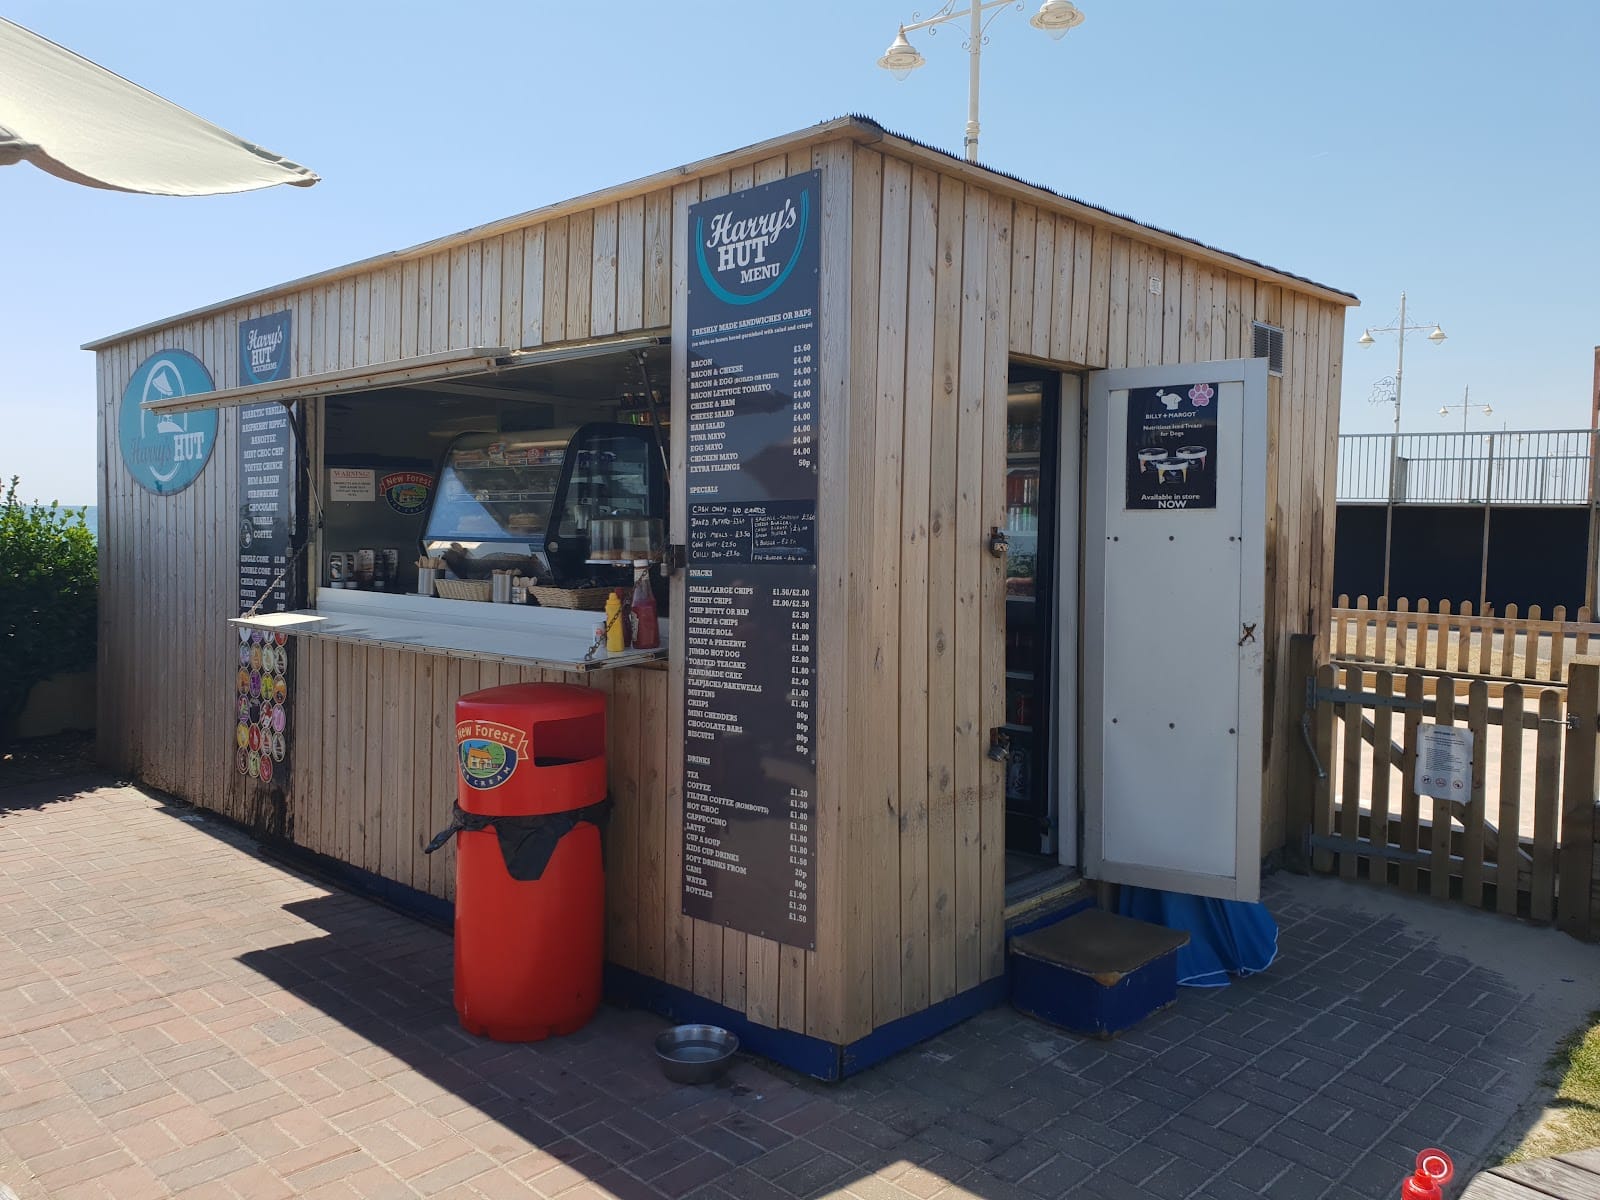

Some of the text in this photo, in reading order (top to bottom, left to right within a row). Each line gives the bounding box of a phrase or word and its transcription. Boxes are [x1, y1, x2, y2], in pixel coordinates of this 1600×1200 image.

[707, 198, 796, 248] Harry's
[718, 236, 768, 271] HUT
[741, 263, 780, 283] MENU
[692, 308, 811, 336] FRESHLY MADE SANDWICHES OR BAPS
[247, 325, 282, 351] Harry's
[252, 346, 271, 366] HUT
[691, 344, 811, 368] BACON £3.60
[691, 370, 712, 379] BACON
[720, 365, 743, 375] CHEESE
[691, 380, 712, 390] BACON
[719, 377, 733, 386] EGG
[691, 383, 771, 400] BACON LETTUCE TOMATO
[691, 402, 713, 411] CHEESE
[721, 399, 735, 407] HAM
[794, 390, 811, 399] £4.00
[691, 402, 811, 421] CHEESE SALAD £4.00
[706, 422, 725, 430] SALAD
[794, 414, 811, 422] £4.00
[708, 433, 726, 441] MAYO
[793, 425, 811, 433] £4.00
[174, 432, 204, 461] HUT
[793, 437, 810, 445] £4.00
[257, 448, 271, 457] CHOC
[691, 455, 718, 463] CHICKEN
[793, 448, 810, 456] £4.00
[711, 464, 740, 472] FILLINGS
[799, 460, 810, 468] 50p
[387, 475, 432, 486] New Forest
[717, 661, 746, 669] TEACAKE
[688, 669, 724, 678] HANDMADE
[688, 690, 715, 698] MUFFINS
[704, 712, 738, 722] CHEDDERS
[688, 720, 726, 730] CHOCOLATE
[475, 725, 516, 744] Forest
[688, 731, 715, 740] BISCUITS
[688, 756, 710, 765] DRINKS
[687, 782, 808, 809] COFFEE £1.50
[687, 792, 708, 802] FILTER
[709, 796, 734, 806] COFFEE
[790, 788, 808, 798] £1.20
[687, 802, 700, 811] HOT
[701, 805, 719, 814] CHOC
[687, 813, 727, 827] CAPPUCCINO
[686, 823, 706, 833] LATTE
[686, 834, 698, 842] CUP
[705, 838, 720, 847] SOUP
[686, 844, 807, 879] KIDS CUP DRINKS 20p
[686, 855, 746, 875] SOFT DRINKS FROM
[686, 865, 702, 874] CANS
[686, 875, 807, 912] WATER £1.20
[686, 886, 807, 924] BOTTLES £1.50
